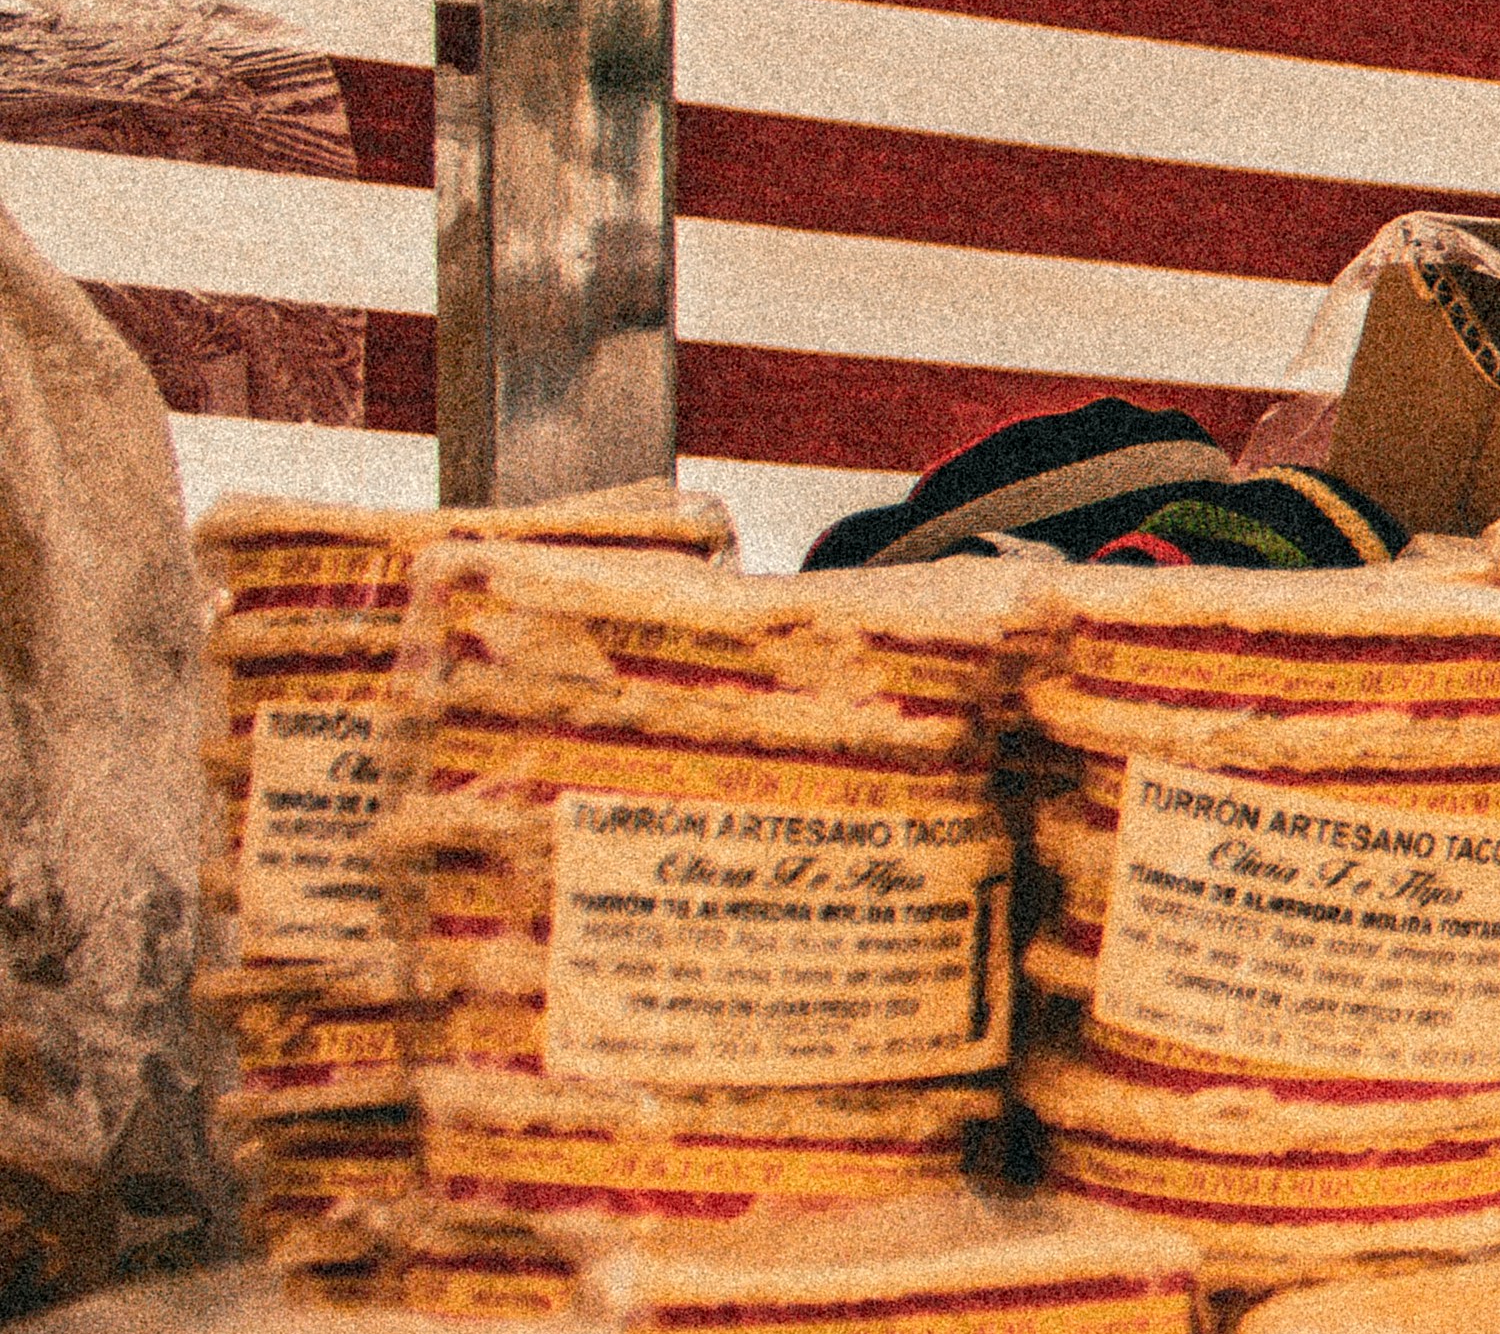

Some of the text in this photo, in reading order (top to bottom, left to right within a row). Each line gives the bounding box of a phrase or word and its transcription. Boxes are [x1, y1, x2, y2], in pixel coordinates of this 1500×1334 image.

[570, 800, 706, 839] TURRÓN
[714, 812, 892, 849] ARTESANO
[1138, 779, 1262, 832] TURRÓN
[1267, 809, 1436, 859] ARTESANO
